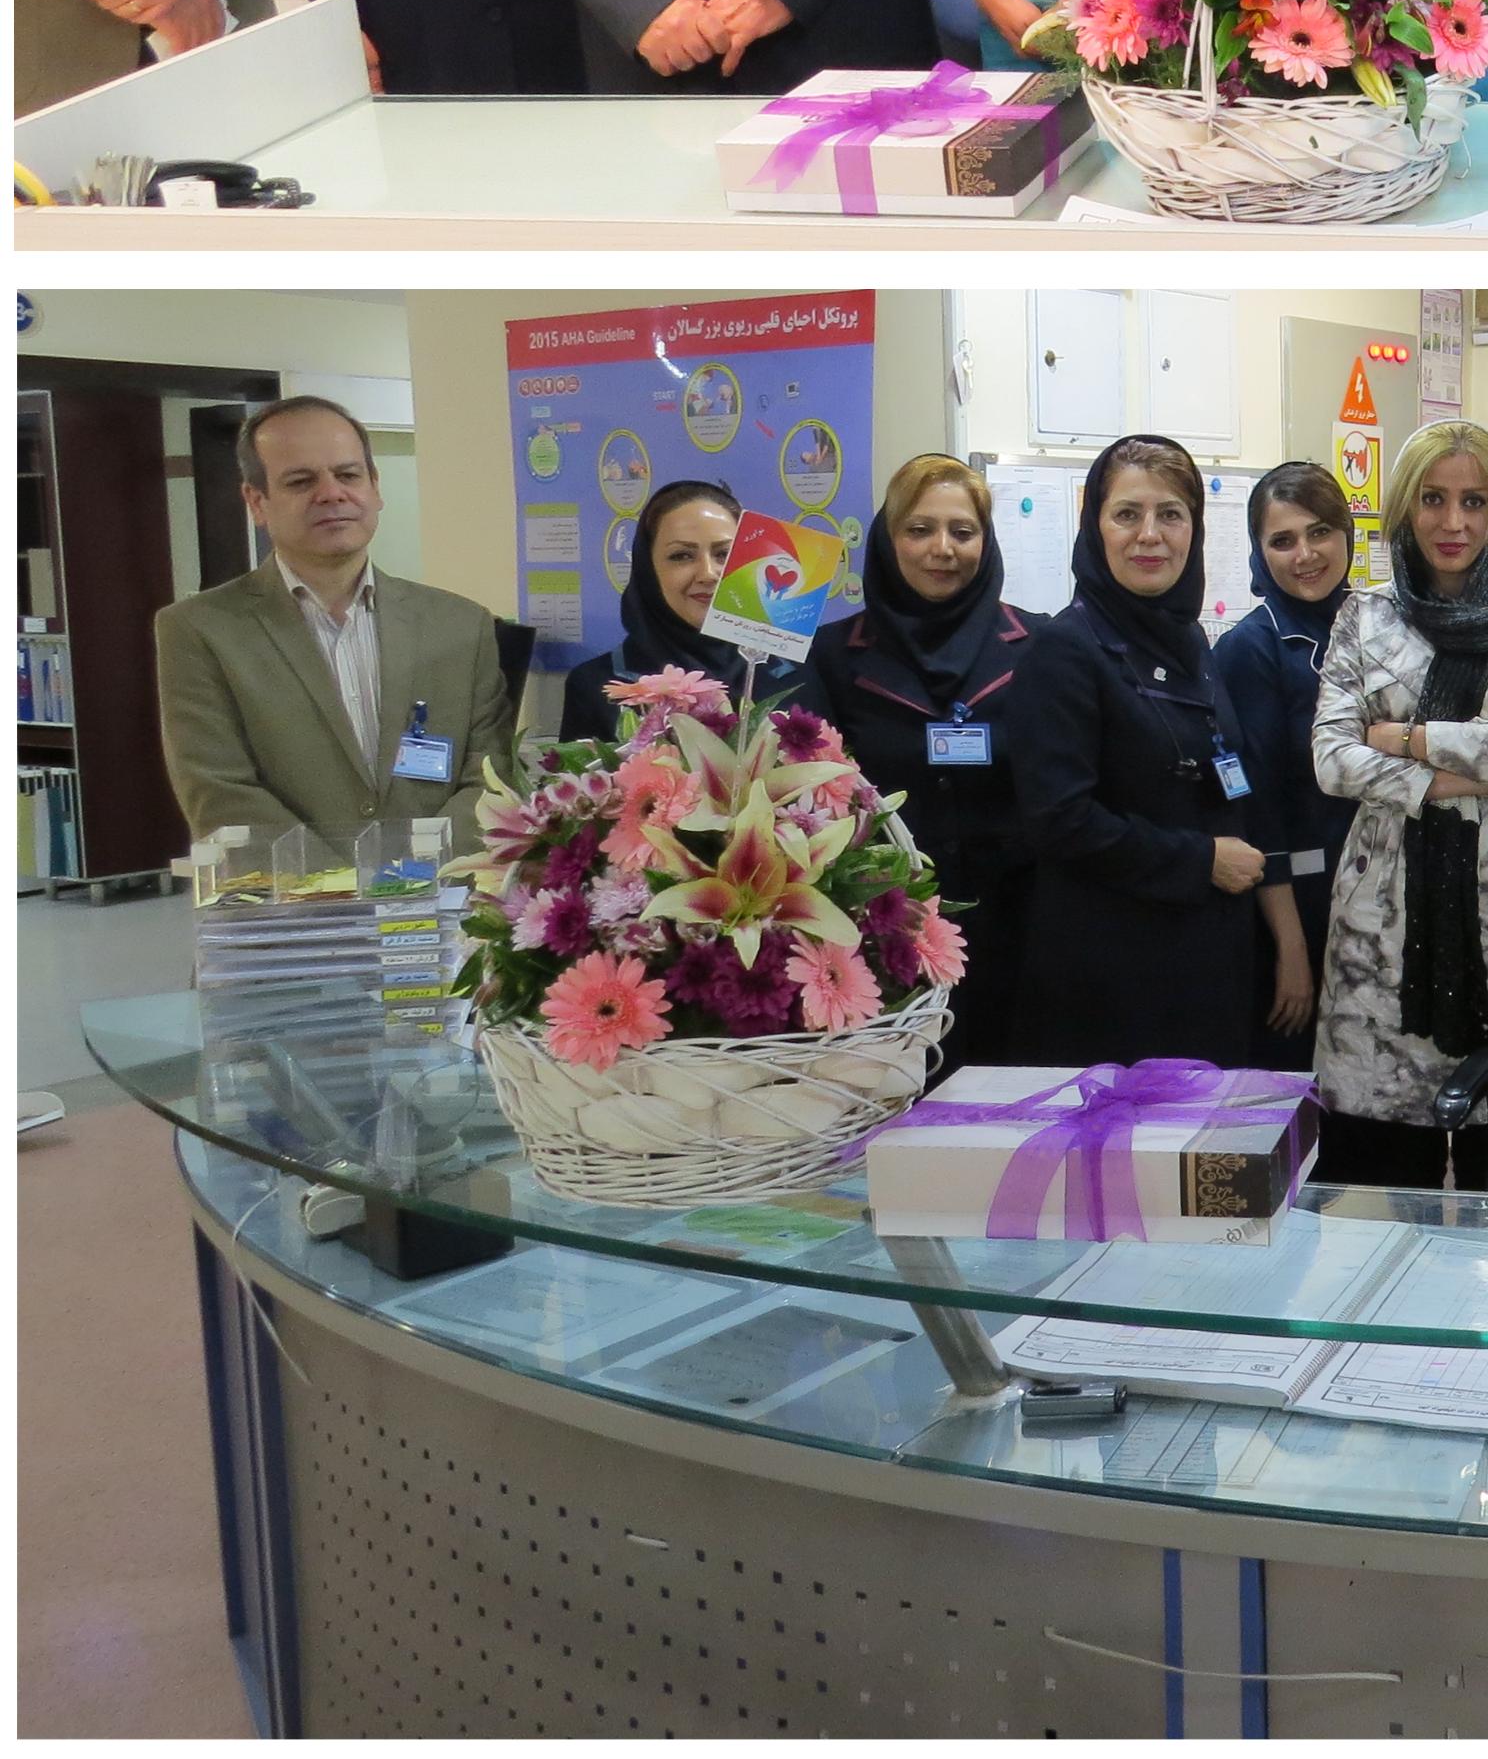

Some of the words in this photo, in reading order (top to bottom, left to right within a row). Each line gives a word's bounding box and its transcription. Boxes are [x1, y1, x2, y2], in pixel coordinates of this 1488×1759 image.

[667, 317, 722, 342] بزرگسالان
[723, 319, 753, 340] ریوی
[755, 311, 781, 335] قلبی
[782, 314, 816, 334] احیای
[822, 306, 859, 330] پروتکل
[529, 332, 559, 351] 2015
[561, 331, 585, 347] AHA
[586, 327, 636, 344] Guideline
